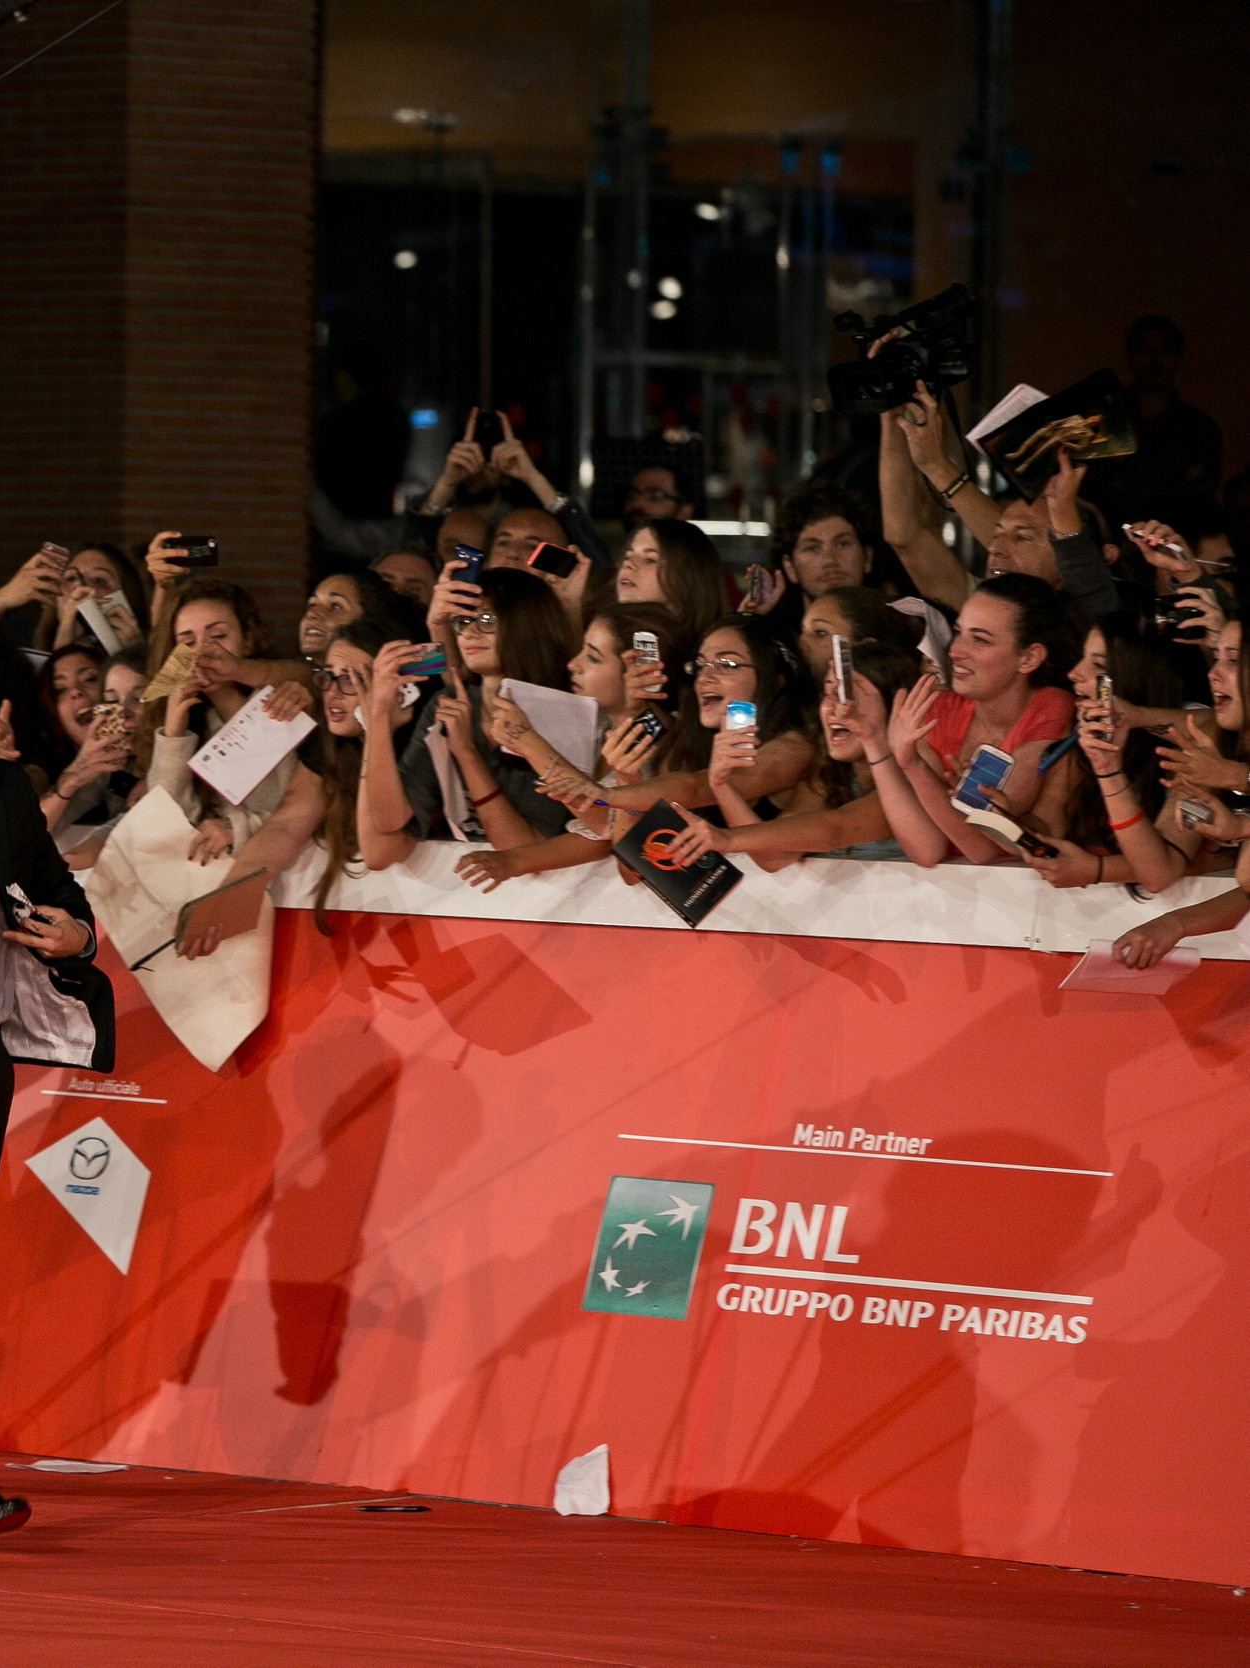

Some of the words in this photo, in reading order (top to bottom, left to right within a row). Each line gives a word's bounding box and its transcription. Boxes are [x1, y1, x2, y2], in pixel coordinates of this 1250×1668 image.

[68, 1077, 96, 1092] Auto
[95, 1079, 142, 1096] ufficiale
[793, 1123, 845, 1150] Main
[848, 1127, 933, 1156] Partner
[728, 1198, 860, 1264] BNL
[716, 1282, 856, 1323] GRUPPO
[861, 1297, 935, 1330] BNP
[939, 1304, 1089, 1345] PARIBAS
